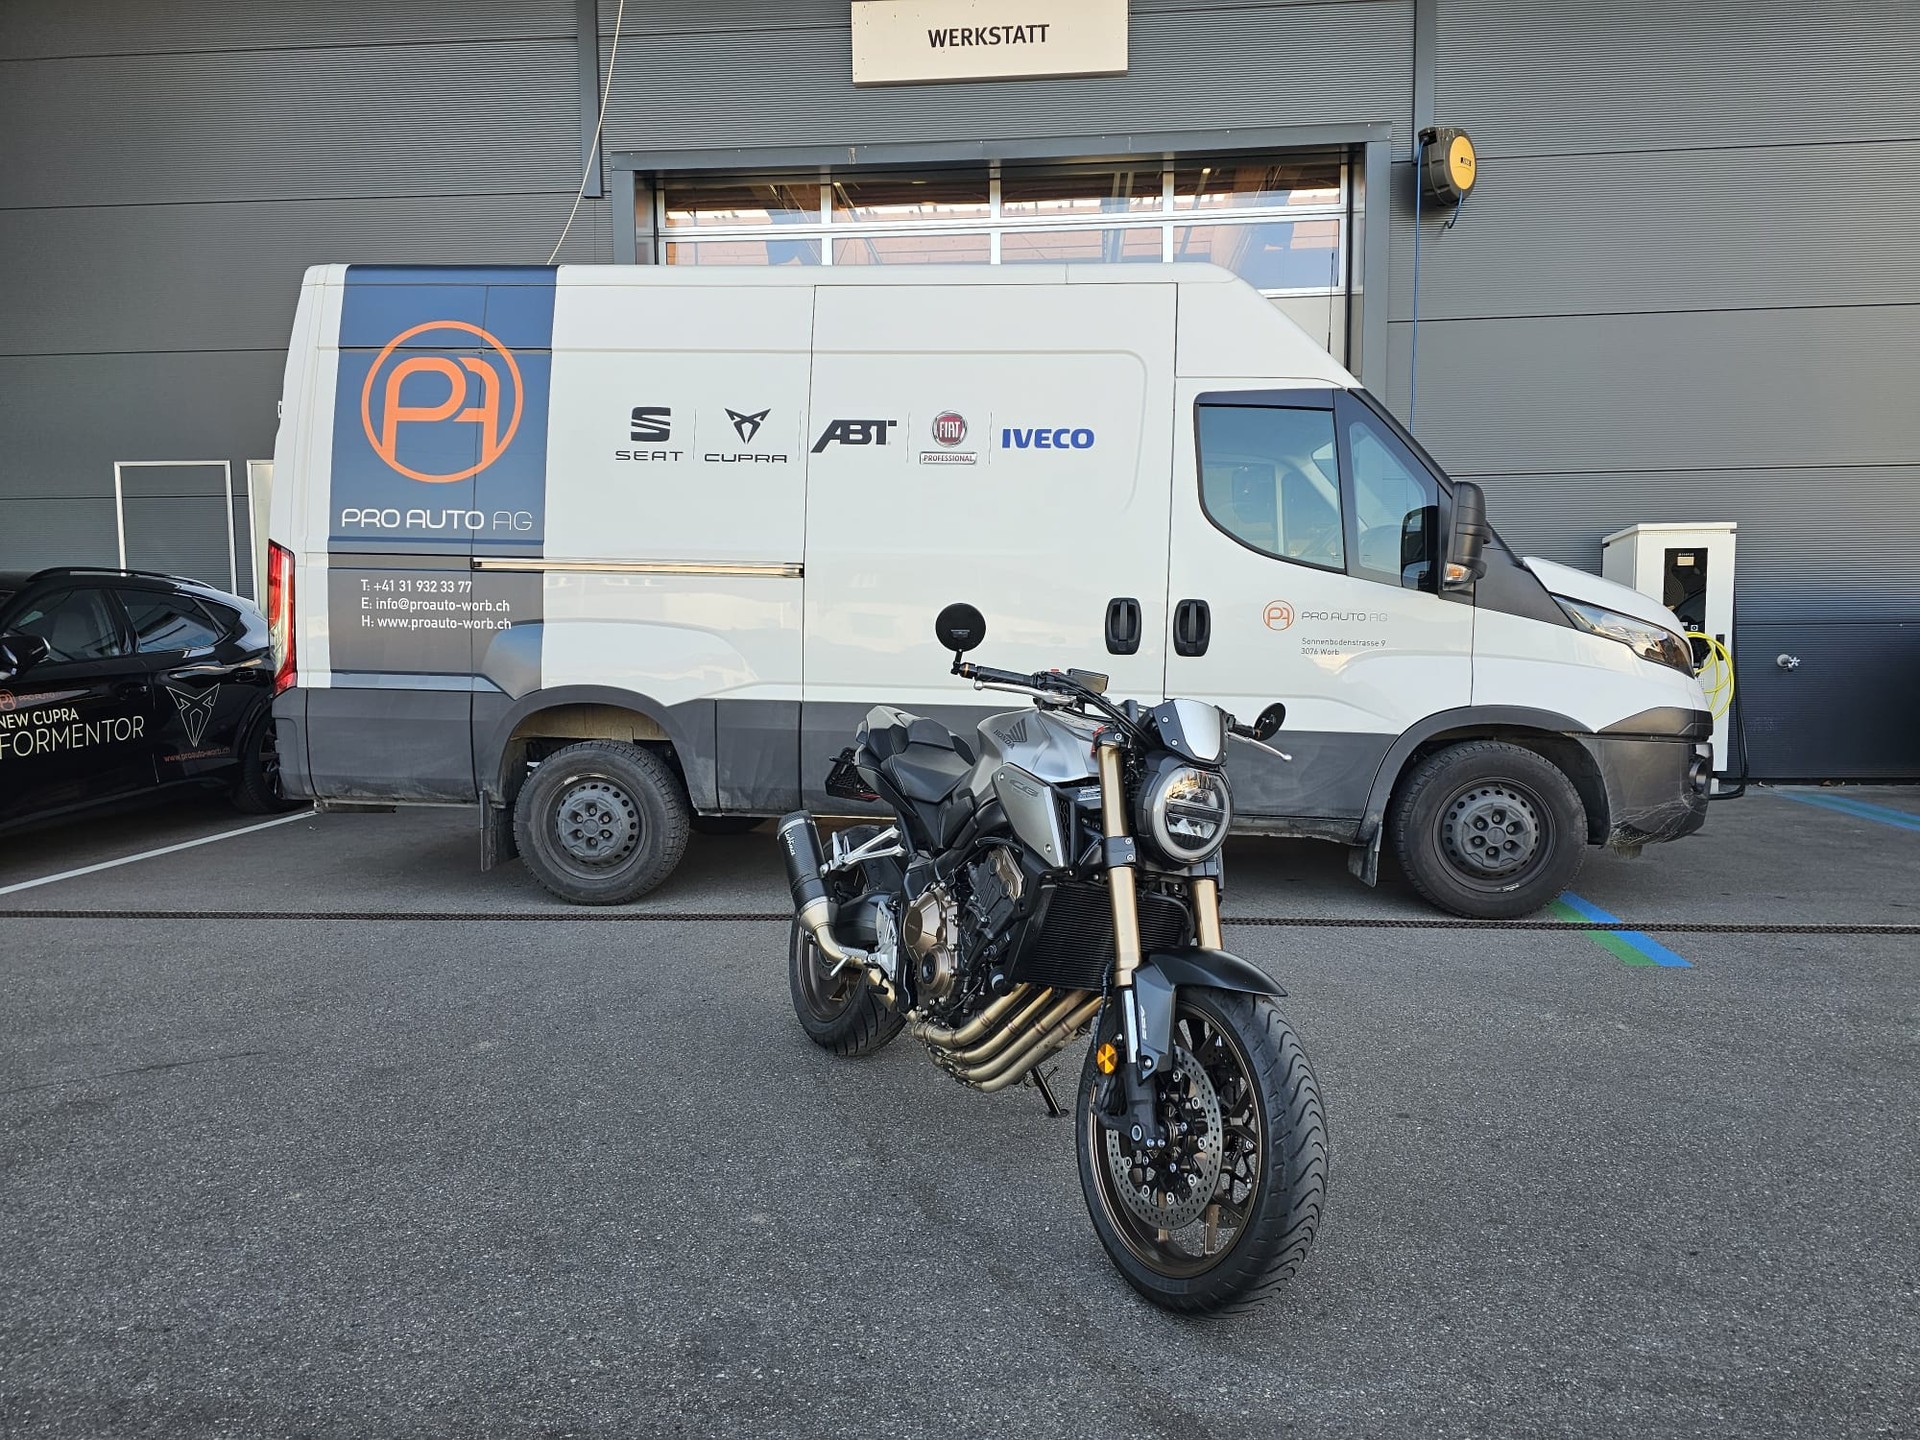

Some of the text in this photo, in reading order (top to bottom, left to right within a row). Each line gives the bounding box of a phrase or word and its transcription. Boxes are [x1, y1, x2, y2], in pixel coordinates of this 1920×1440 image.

[928, 24, 1050, 48] WERKSTATT
[810, 419, 898, 453] ABT
[940, 421, 961, 438] FIAT
[1001, 428, 1095, 449] IVECO
[615, 450, 684, 462] SEAT
[704, 453, 787, 463] CUPRA
[923, 454, 974, 462] PROFESSIONAL
[341, 508, 533, 531] PRO AUTO AG
[361, 579, 472, 593] T: +41 31 932 33 77
[361, 597, 510, 613] E: info@proauto-worb.ch
[361, 615, 512, 631] H: www.proauto-worb.ch
[1301, 611, 1388, 622] PRO AUTO AG
[1301, 638, 1379, 647] Sonnenbodenstrasse
[1320, 648, 1340, 656] Worb
[32, 707, 80, 725] CUPRA
[0, 715, 145, 760] FORMENTOR
[993, 729, 1015, 750] HONDA
